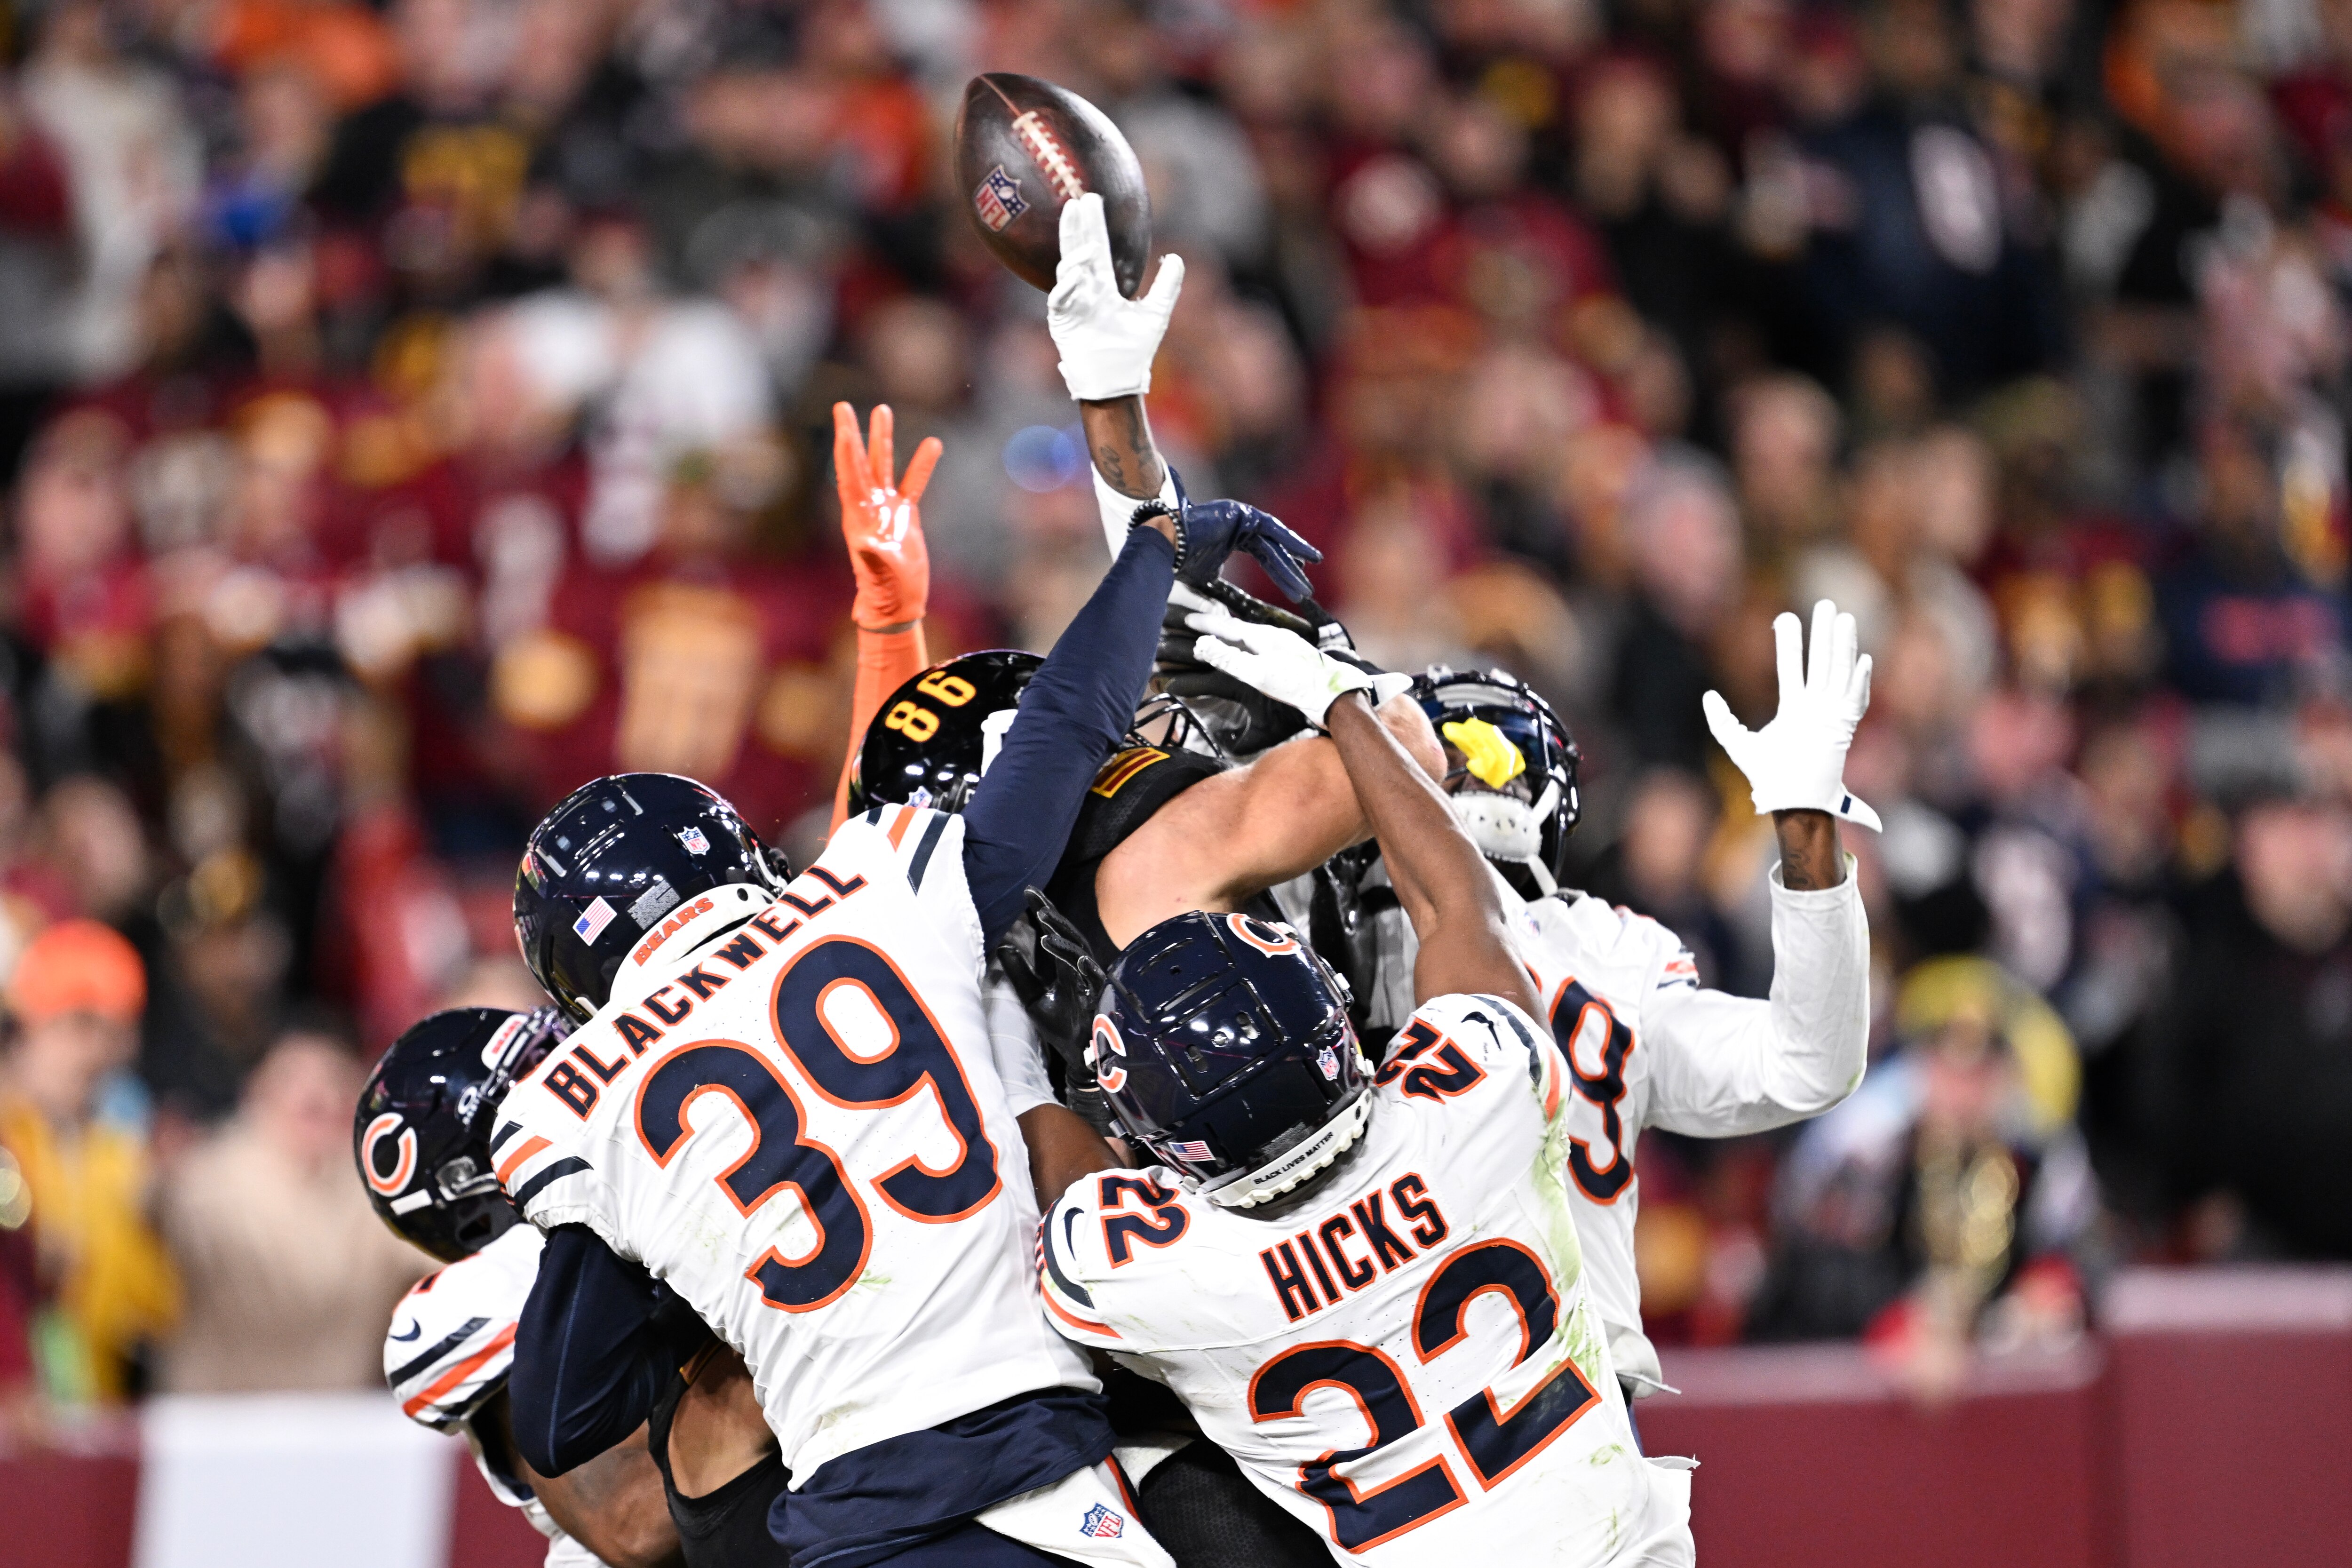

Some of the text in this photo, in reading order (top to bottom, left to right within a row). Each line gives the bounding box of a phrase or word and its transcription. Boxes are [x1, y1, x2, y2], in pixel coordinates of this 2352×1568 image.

[976, 186, 1006, 230] NFL
[885, 670, 977, 742] 86
[688, 838, 707, 851] NFL
[632, 897, 714, 966] BEARS
[542, 865, 868, 1121] BLACKWELL
[1373, 1017, 1488, 1105] 22
[1523, 960, 1635, 1206] 9
[634, 934, 1002, 1313] 39
[1253, 1131, 1334, 1185] BLACK LIVES MATTER
[1097, 1175, 1191, 1269] 22
[1258, 1172, 1450, 1322] HICKS
[1247, 1237, 1602, 1554] 22
